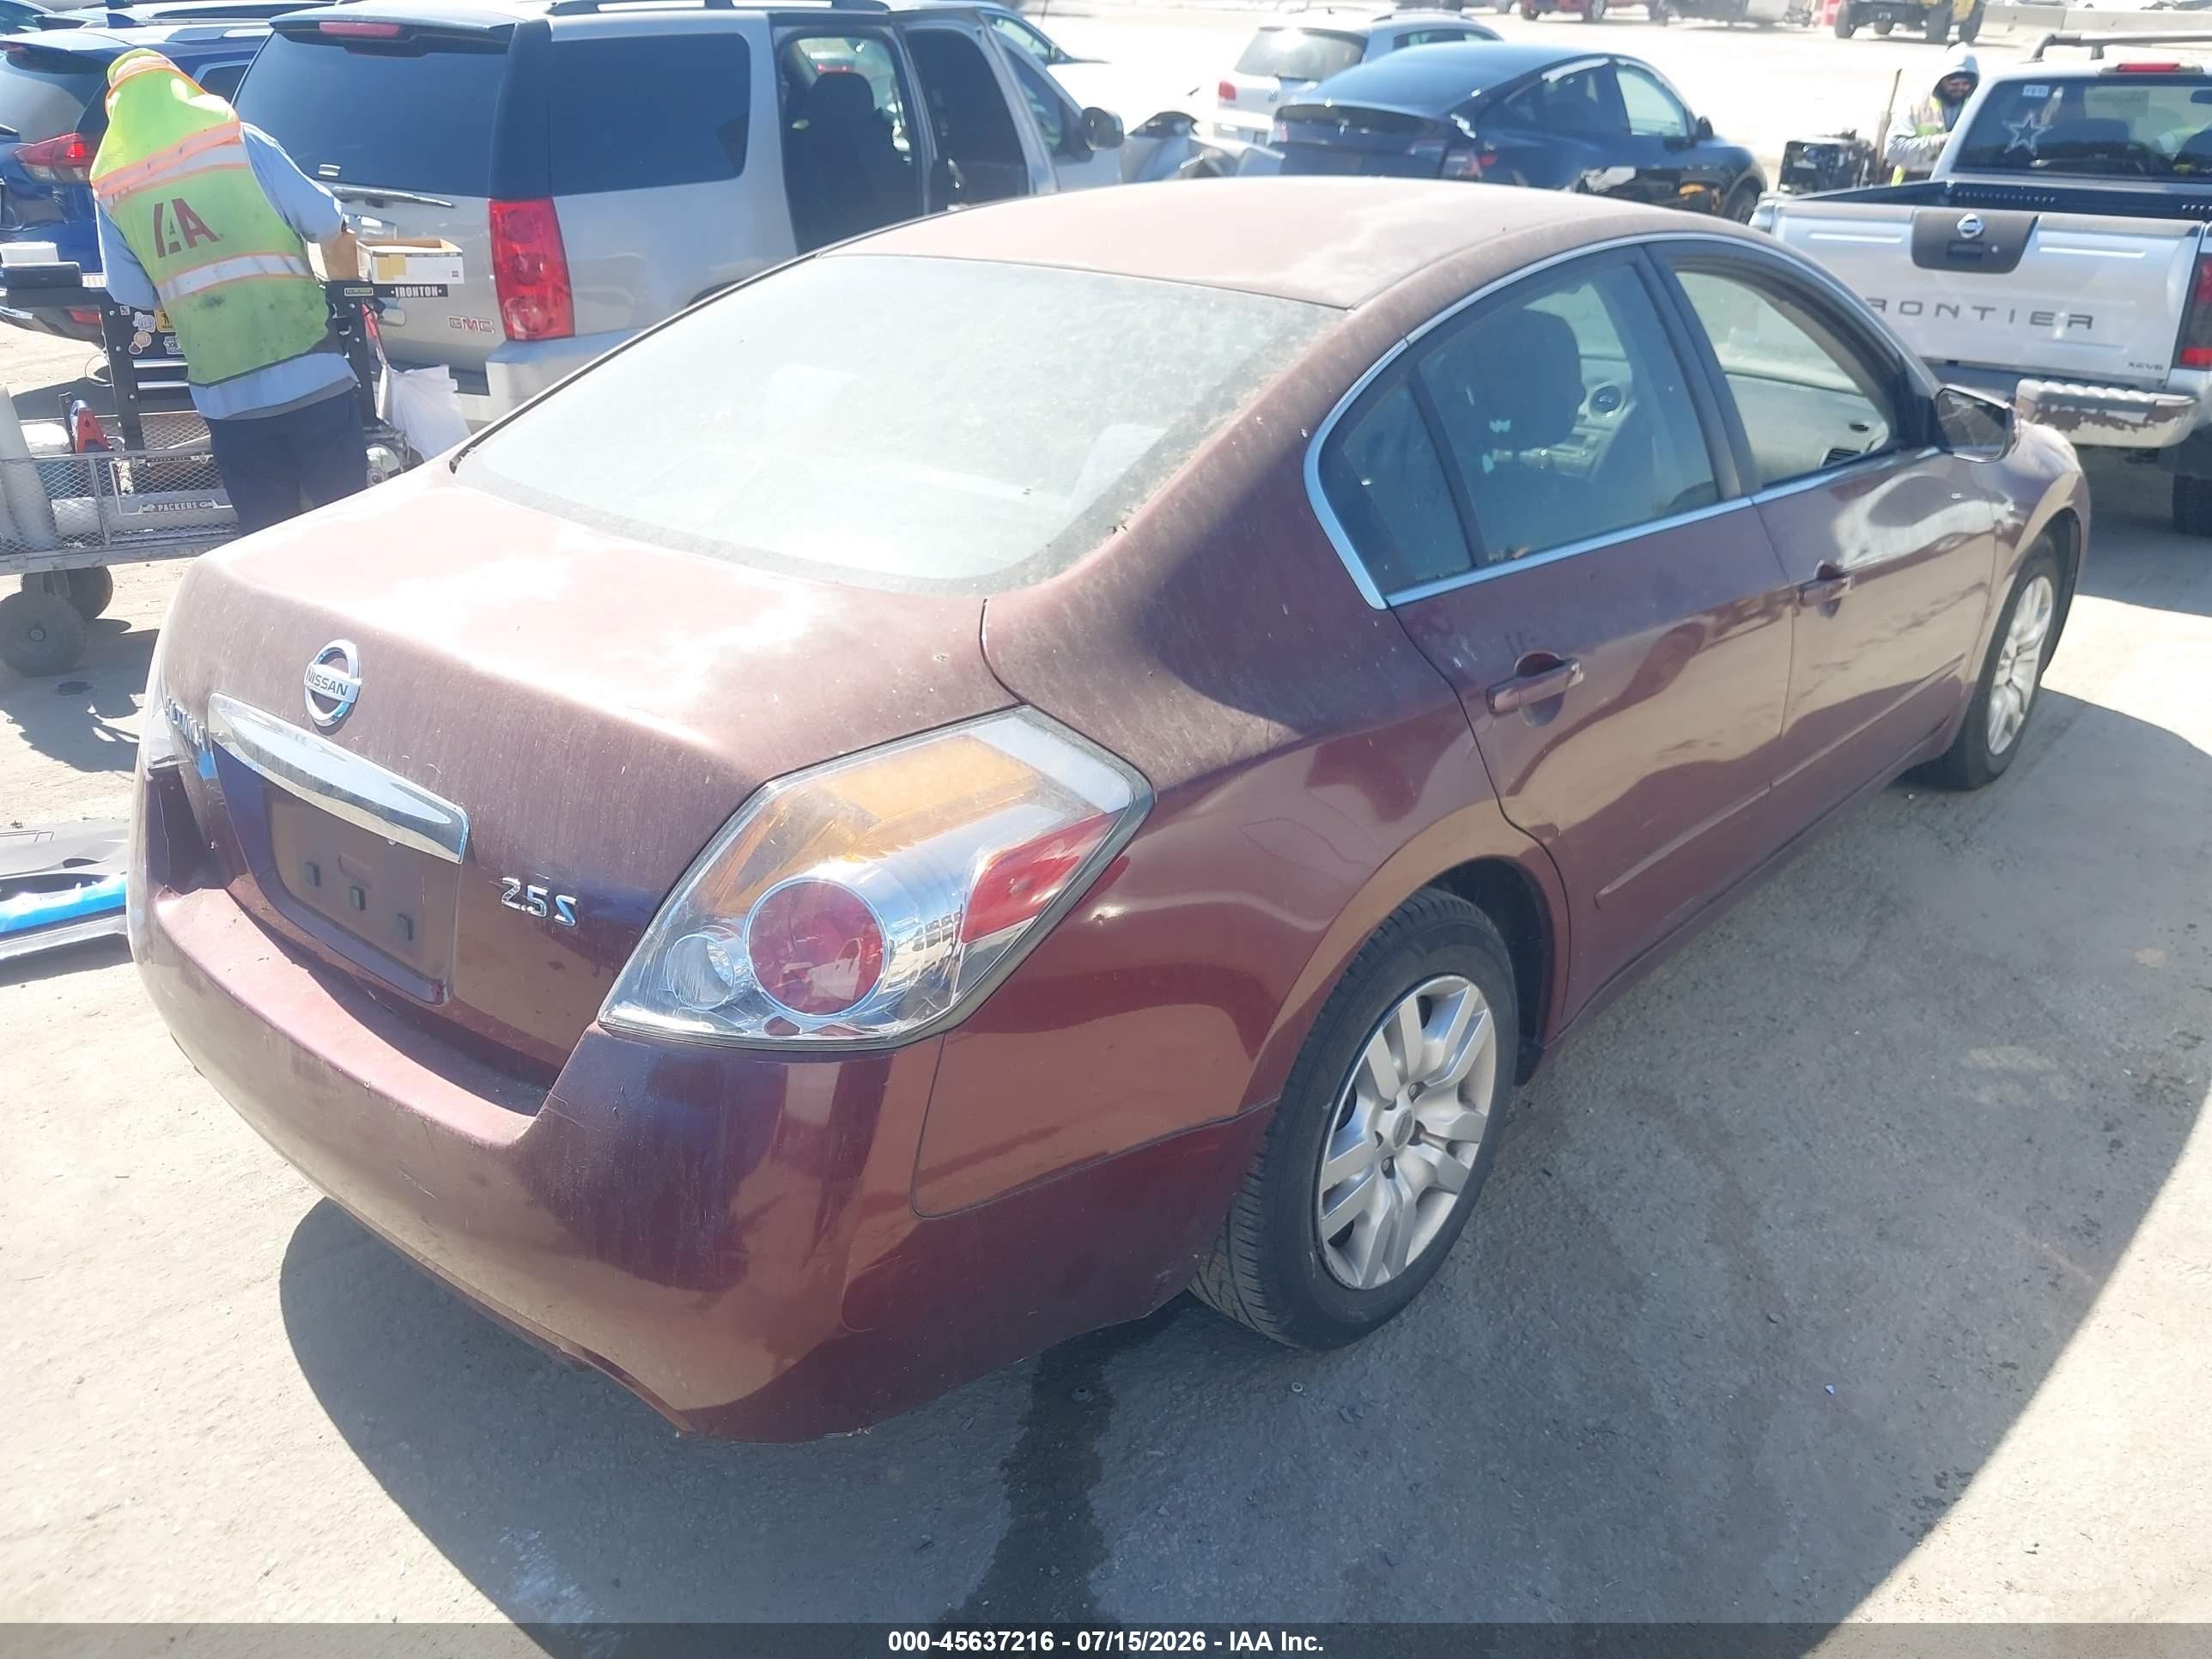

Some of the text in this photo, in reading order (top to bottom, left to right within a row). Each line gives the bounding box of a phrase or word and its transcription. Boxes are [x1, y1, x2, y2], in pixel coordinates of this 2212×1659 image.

[395, 286, 439, 298] IRONTON
[448, 315, 496, 334] GMC
[1865, 298, 2094, 330] RONTIER
[158, 501, 198, 512] PACKERS
[306, 669, 349, 696] NISSAN
[501, 877, 577, 927] 2.5 S
